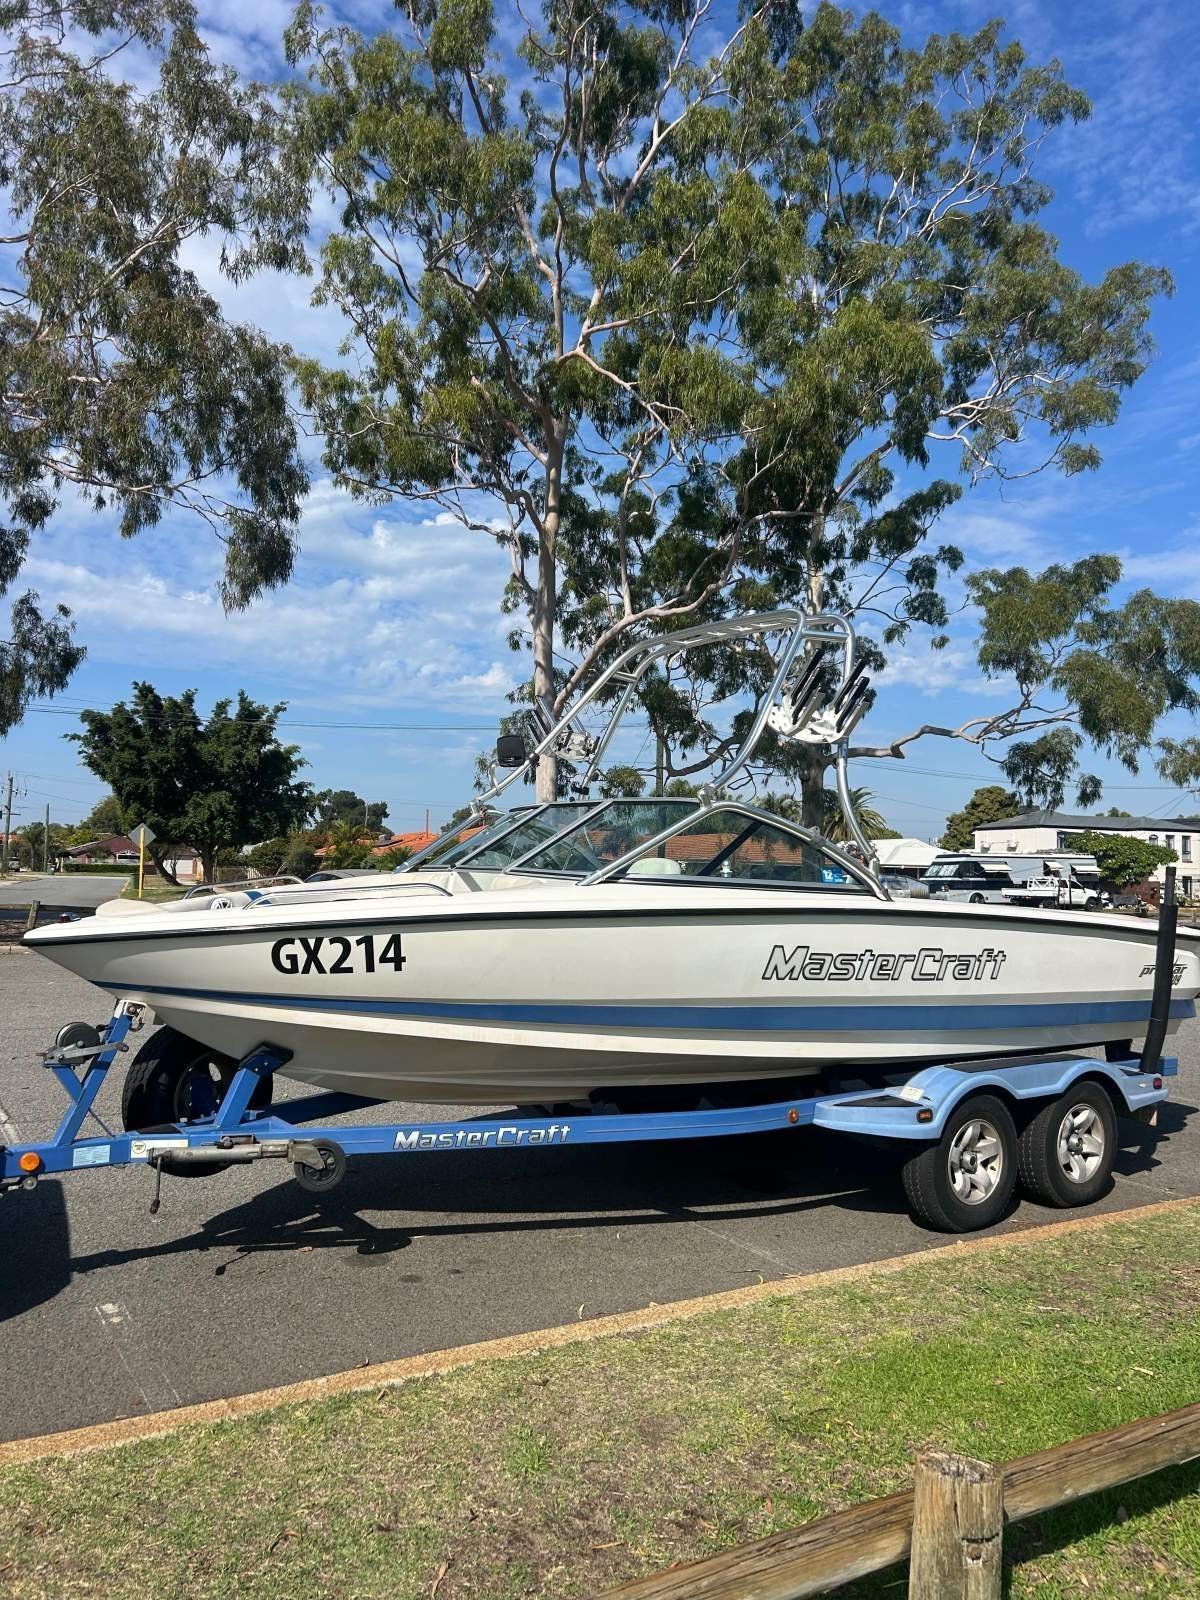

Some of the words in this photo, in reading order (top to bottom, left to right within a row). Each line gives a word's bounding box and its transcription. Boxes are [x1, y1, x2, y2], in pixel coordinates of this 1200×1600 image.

[271, 934, 406, 974] GX214
[761, 945, 1007, 981] MasterCraft
[392, 1125, 571, 1150] MasterCraft
